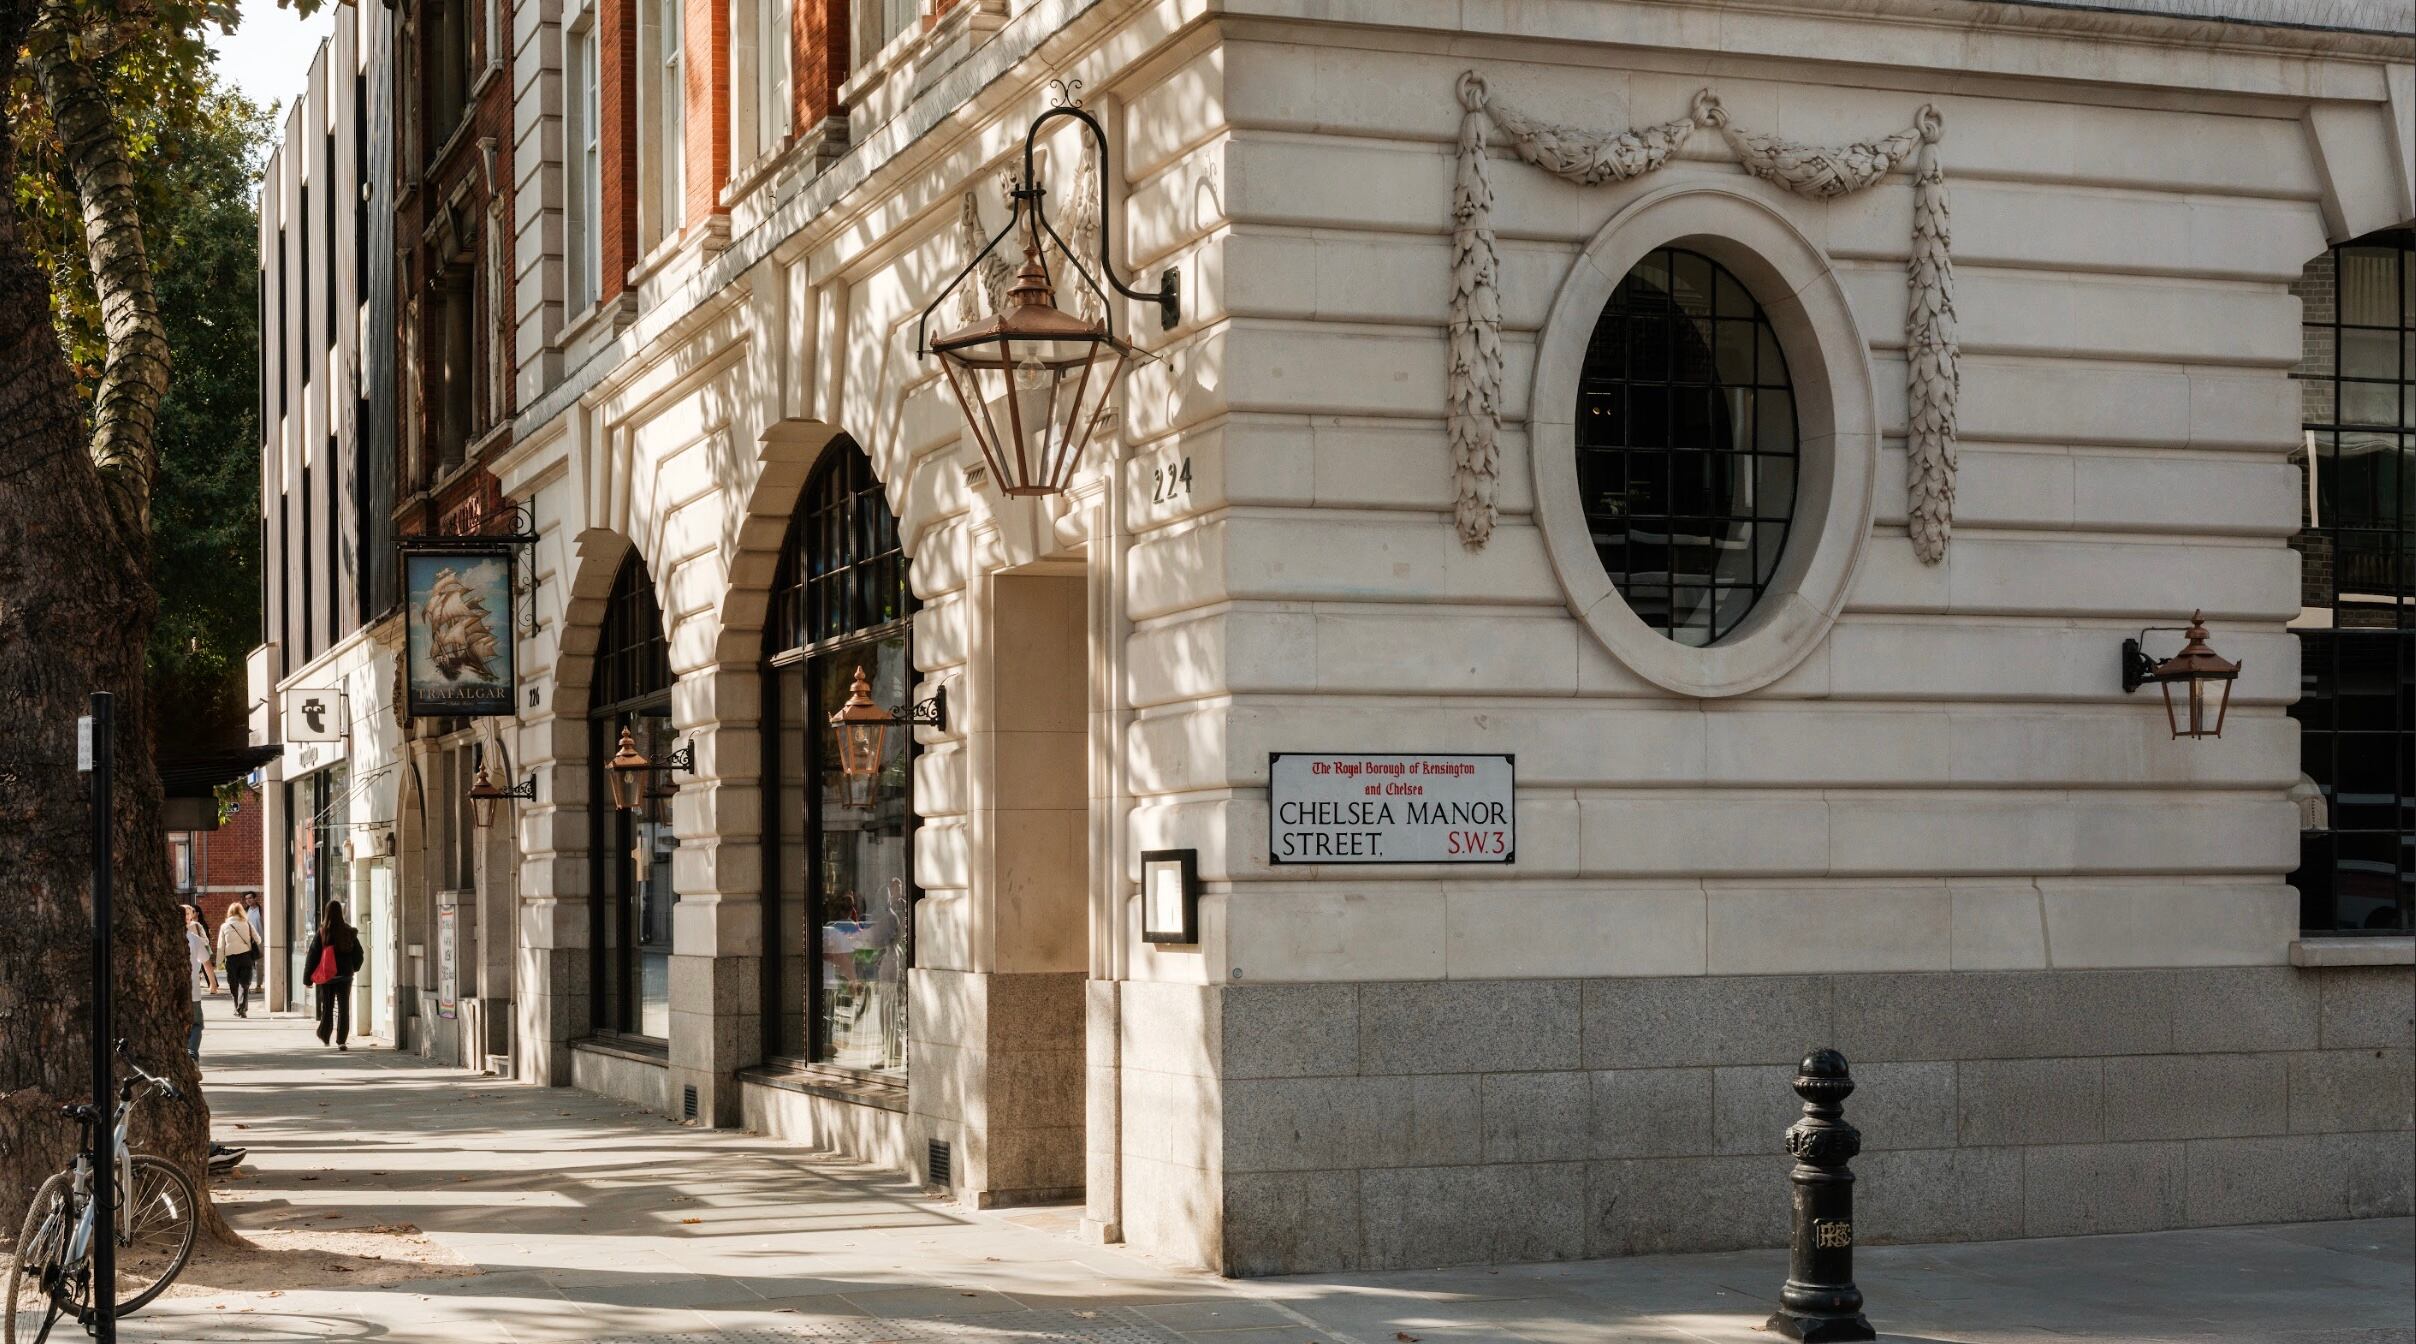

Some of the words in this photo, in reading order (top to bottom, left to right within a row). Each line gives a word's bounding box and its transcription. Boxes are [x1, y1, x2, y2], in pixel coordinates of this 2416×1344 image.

[1153, 456, 1192, 505] 224
[418, 687, 505, 699] TRAFALGAR
[1312, 762, 1331, 775] The
[1333, 761, 1362, 778] Royal
[1365, 762, 1405, 778] Borough
[1409, 761, 1419, 775] of
[1422, 762, 1475, 778] Kensington
[1364, 783, 1381, 795] and
[1385, 782, 1424, 796] Chelsea
[1279, 801, 1396, 825] CHELSEA
[1406, 801, 1508, 825] MANOR
